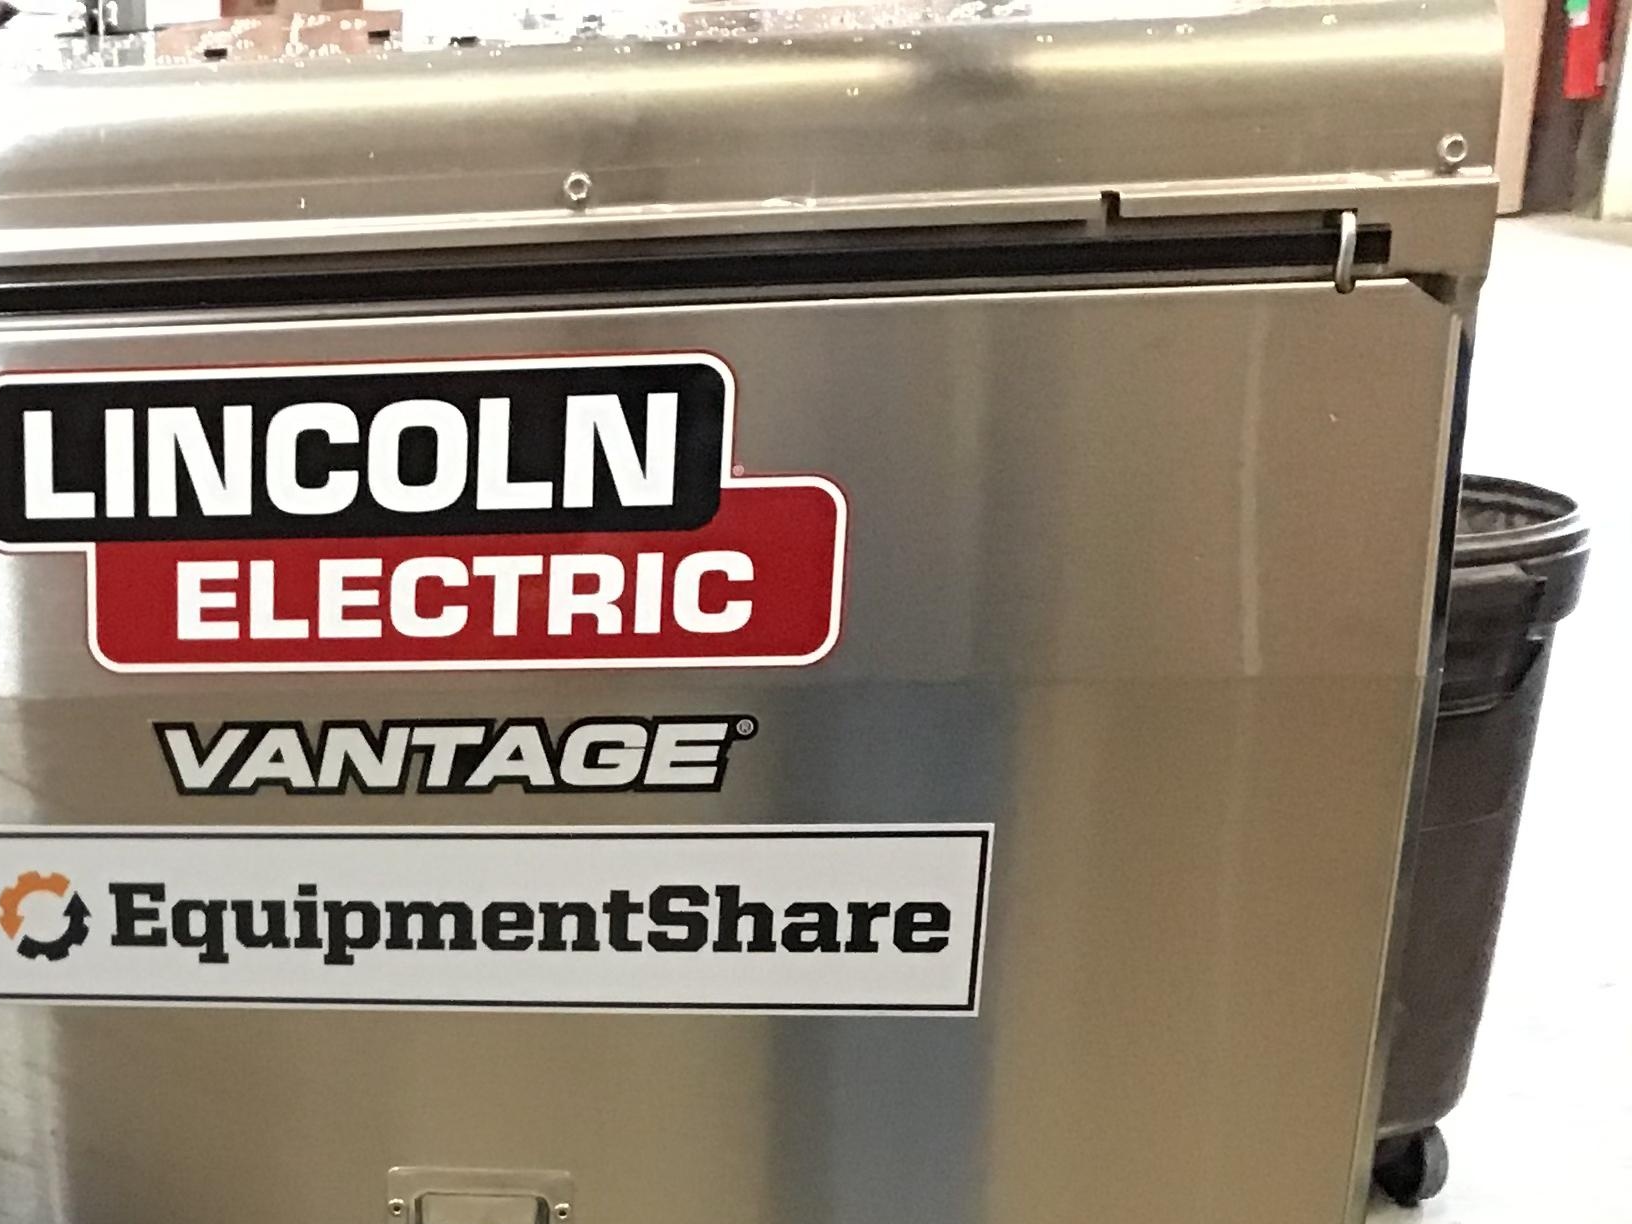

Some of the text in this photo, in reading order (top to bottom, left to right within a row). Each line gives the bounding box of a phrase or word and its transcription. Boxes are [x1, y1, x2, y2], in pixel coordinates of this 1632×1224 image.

[23, 393, 678, 520] LINCOLN
[176, 550, 755, 640] ELECTRIC
[108, 882, 952, 967] EquipmentShare
